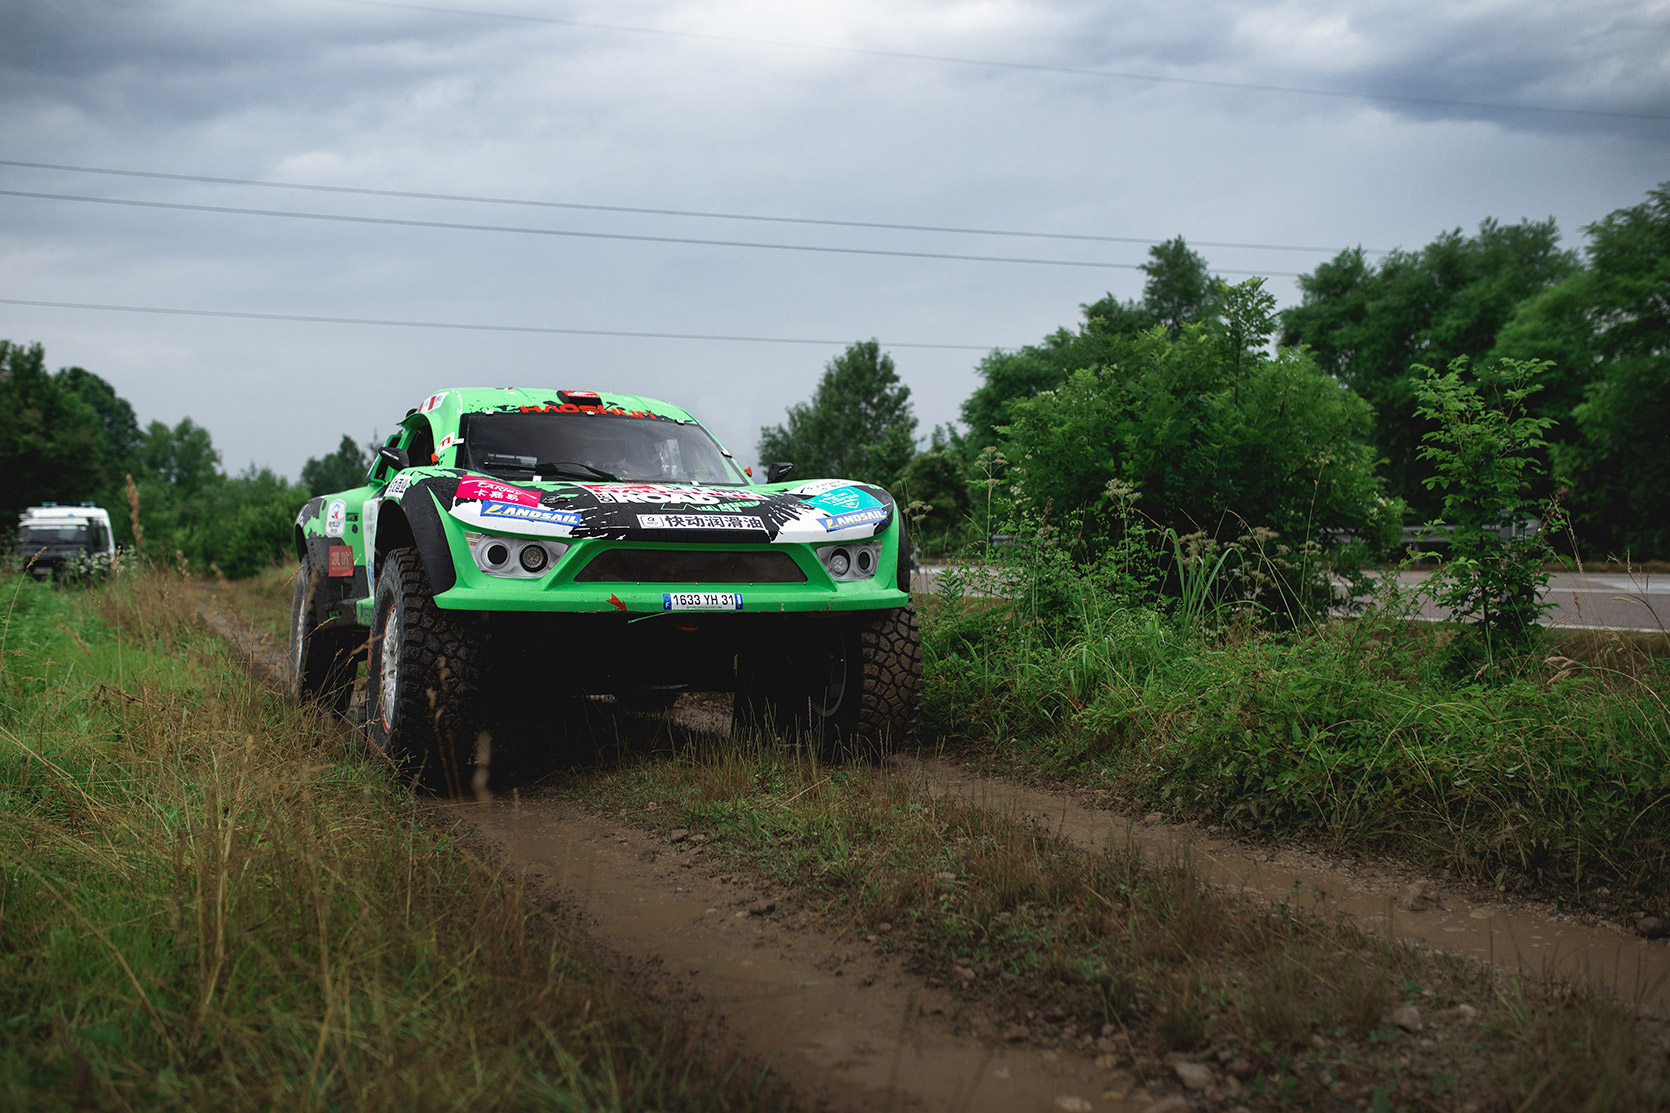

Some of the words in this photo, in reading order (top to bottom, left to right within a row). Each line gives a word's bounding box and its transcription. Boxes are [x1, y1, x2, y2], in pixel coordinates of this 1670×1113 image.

[612, 489, 721, 505] ROAD
[484, 504, 579, 524] LANDSAIL
[665, 515, 764, 529] 快动润滑油
[825, 511, 887, 529] LANDSAIL
[673, 594, 701, 606] 1633
[703, 594, 719, 606] YH
[721, 594, 734, 606] 31
